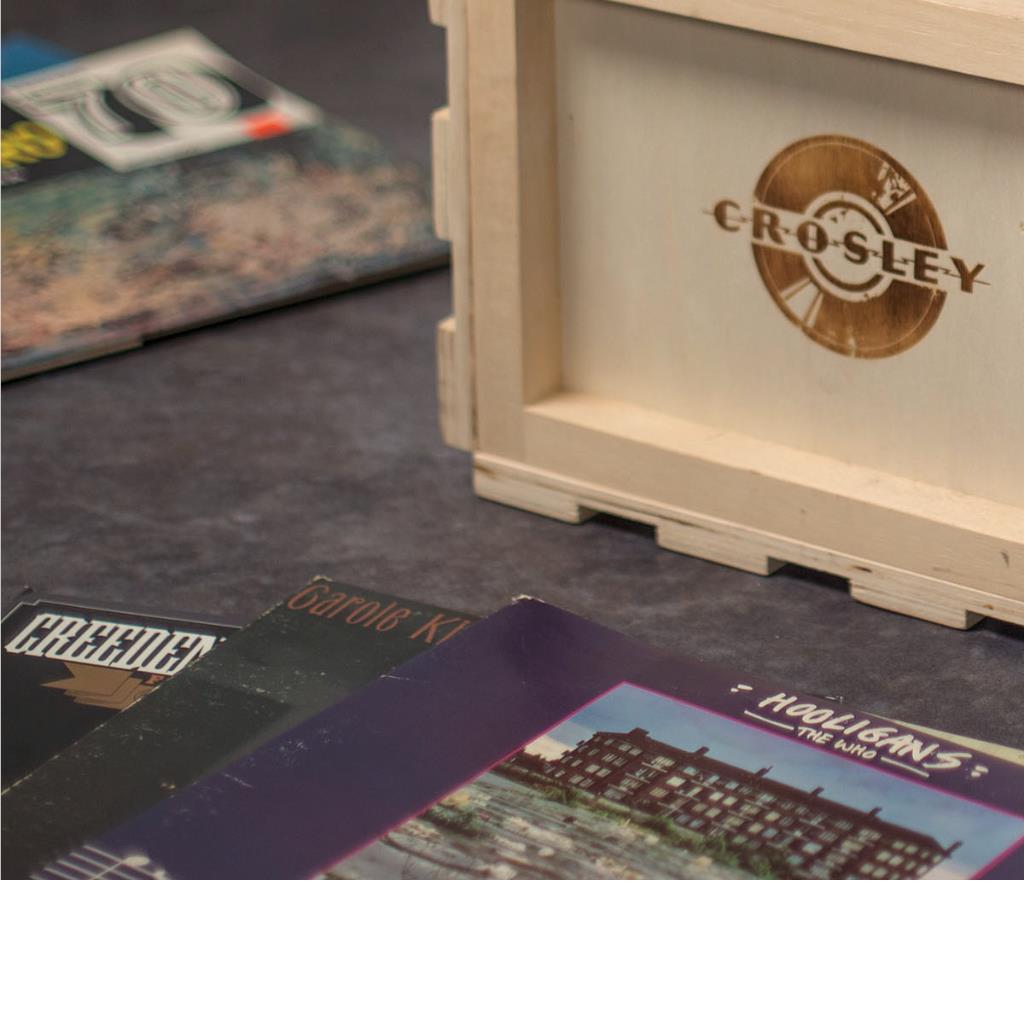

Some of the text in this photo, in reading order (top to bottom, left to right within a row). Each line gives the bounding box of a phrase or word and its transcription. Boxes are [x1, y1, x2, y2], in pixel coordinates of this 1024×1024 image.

[713, 198, 985, 294] CROSLEY
[757, 692, 974, 770] HOOLIGANS
[797, 726, 878, 760] THE WHO
